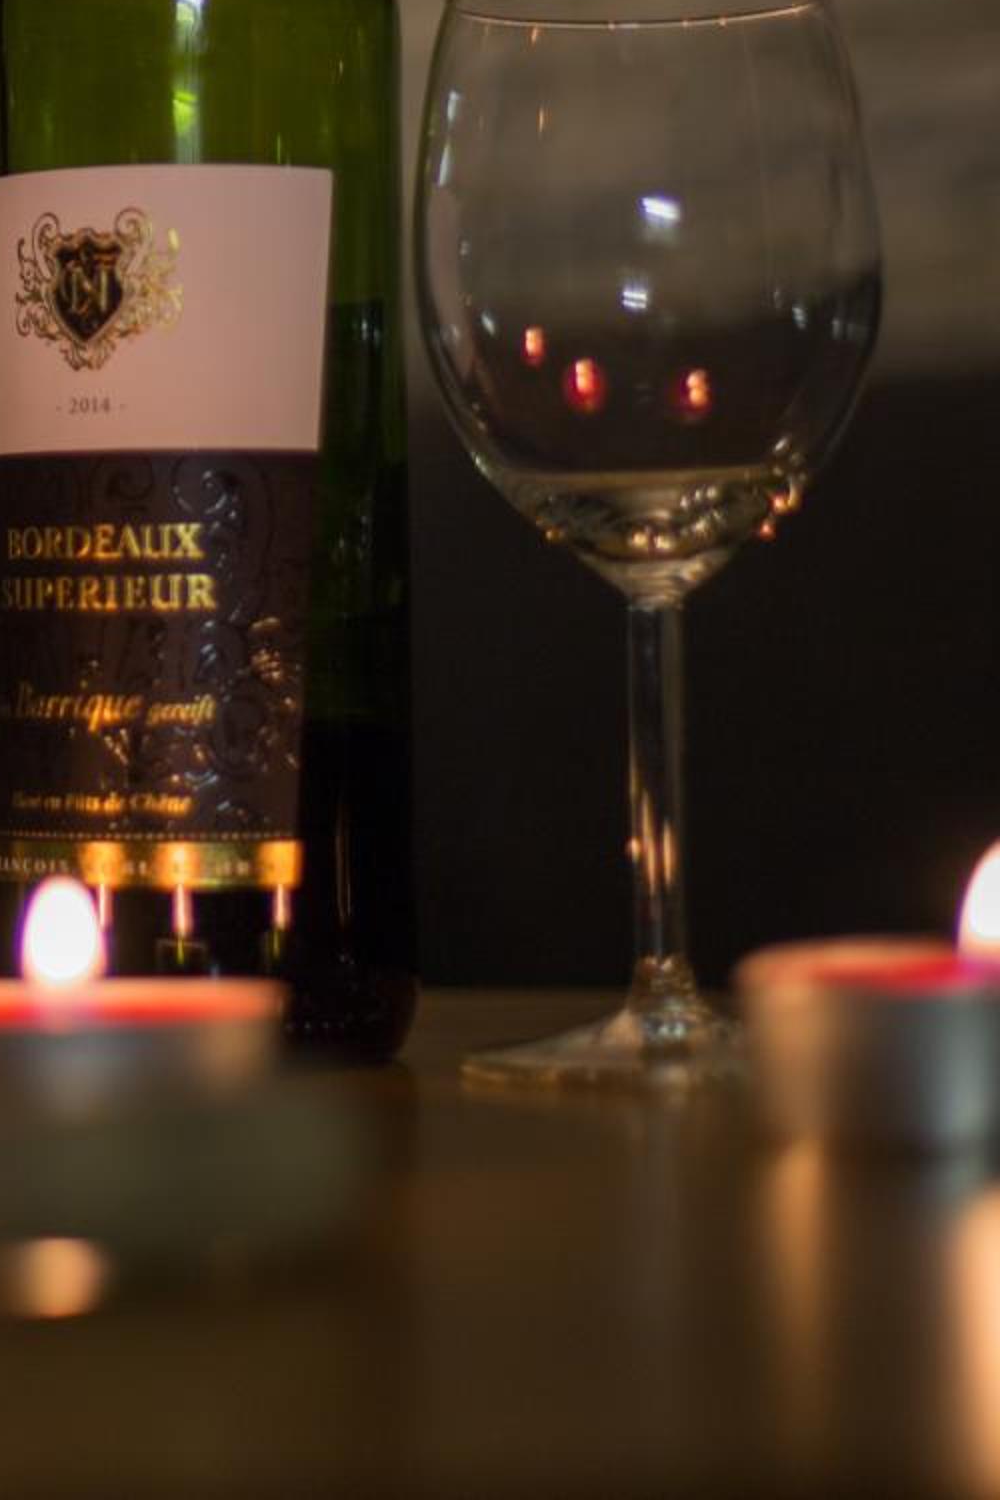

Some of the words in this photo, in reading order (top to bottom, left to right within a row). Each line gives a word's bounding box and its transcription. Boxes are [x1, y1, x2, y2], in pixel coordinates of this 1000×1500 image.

[68, 398, 111, 414] 2014
[7, 523, 204, 561] BORDEAUX
[1, 573, 216, 611] SUPERIEUR
